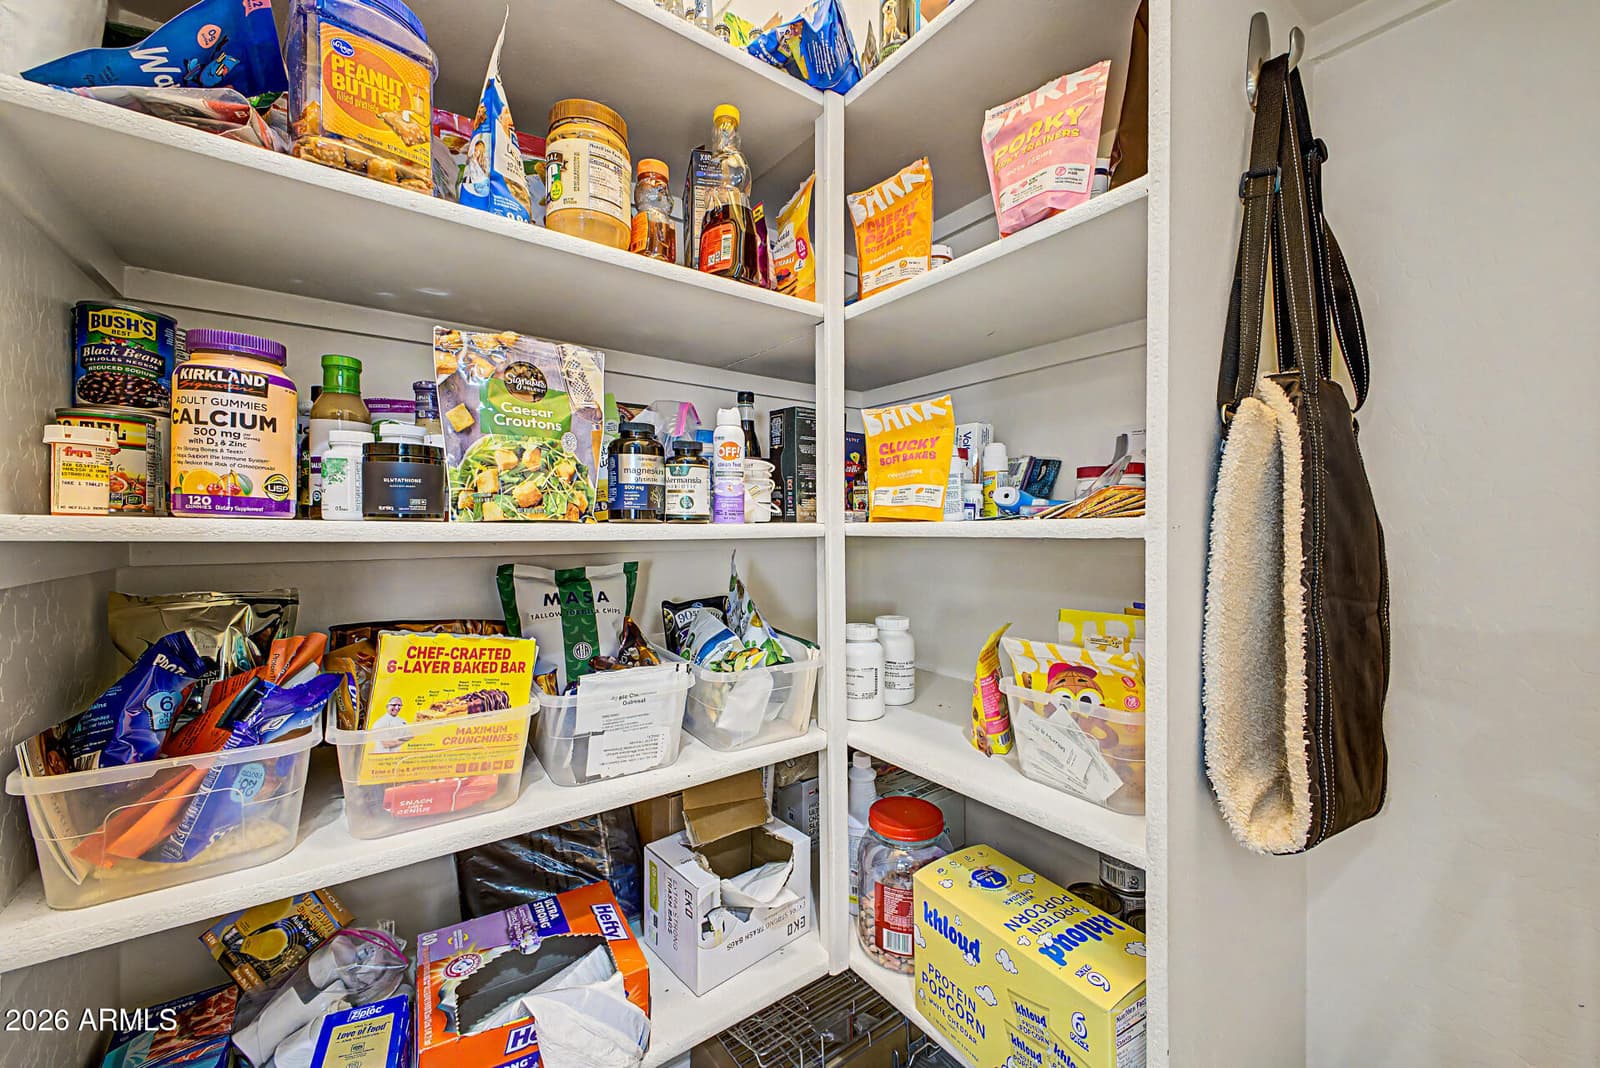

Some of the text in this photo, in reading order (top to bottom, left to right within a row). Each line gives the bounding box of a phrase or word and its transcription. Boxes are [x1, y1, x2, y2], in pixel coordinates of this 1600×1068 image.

[331, 54, 403, 97] PEANUT
[332, 72, 401, 110] BUTTER
[994, 105, 1088, 165] PORKY
[1022, 128, 1081, 154] TRAINERS
[91, 313, 154, 338] BUSH'S
[111, 329, 132, 337] BEST
[82, 345, 163, 367] Black Beans
[180, 367, 266, 388] KIRKLAND
[176, 396, 268, 413] ADULT GUMMIES
[501, 401, 554, 418] Caesar
[172, 407, 277, 433] CALCIUM
[493, 413, 563, 432] Croutons
[193, 428, 241, 441] 500 mg
[228, 440, 248, 448] Zinc
[717, 446, 741, 459] OFF!
[879, 436, 940, 456] CLUCKY
[880, 450, 937, 467] SOFT BAKES
[188, 495, 212, 505] 120
[267, 484, 289, 494] USP
[543, 591, 610, 607] MASA
[531, 611, 562, 621] TALLOW
[406, 646, 511, 661] CHEF-CRAFTED
[387, 660, 526, 674] 6-LAYER BAKED BAR
[160, 695, 173, 712] 6
[442, 733, 519, 746] CRUNCHINESS
[455, 725, 508, 736] MAXIMUM
[544, 898, 560, 920] ULTRA
[684, 888, 693, 920] EKO
[1003, 894, 1073, 932] POPCORN
[311, 903, 335, 933] Dawn
[533, 902, 551, 929] STRONG
[595, 904, 622, 938] Hefty
[787, 915, 806, 937] EKO
[1028, 904, 1080, 936] PROTEIN
[923, 900, 981, 963] khloud
[1038, 914, 1126, 967] khloud
[928, 962, 976, 1014] PROTEIN
[1087, 971, 1111, 993] 6
[348, 1005, 384, 1022] Ziploc
[921, 971, 986, 1040] POPCORN
[1014, 1001, 1047, 1028] khloud
[1071, 1011, 1088, 1040] 6
[1010, 1032, 1043, 1065] khloud
